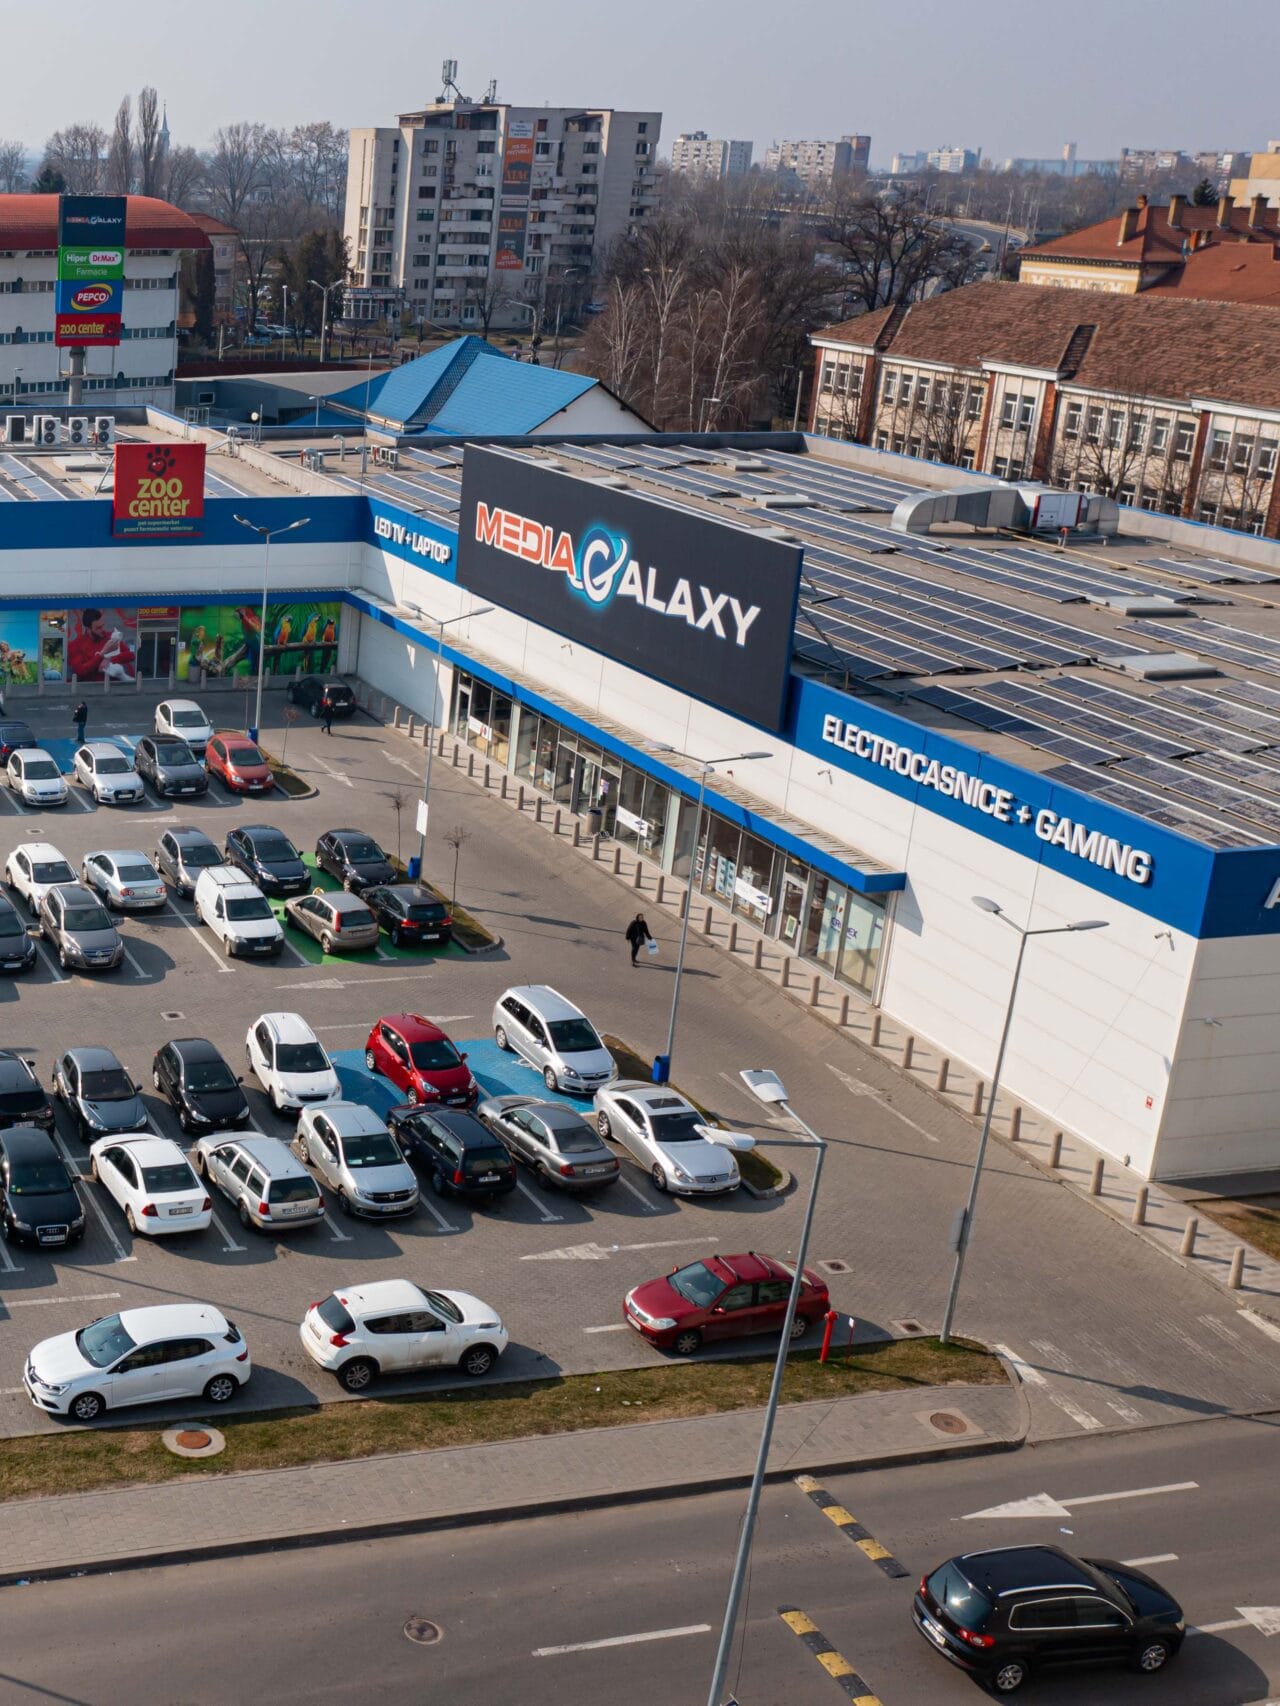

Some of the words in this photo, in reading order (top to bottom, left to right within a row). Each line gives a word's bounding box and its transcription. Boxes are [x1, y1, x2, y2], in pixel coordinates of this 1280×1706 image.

[66, 254, 87, 263] Hiper
[76, 267, 108, 276] Farmacie
[77, 292, 106, 302] PEPCO
[60, 325, 76, 334] zoo
[78, 322, 104, 334] center
[137, 478, 183, 498] zoo
[129, 496, 190, 517] center
[374, 515, 392, 538] LED
[392, 521, 404, 543] TV
[412, 533, 450, 565] LAPTOP
[475, 500, 576, 577] MEDIA
[570, 530, 761, 647] GALAXY
[822, 714, 1013, 822] ELECTROCASNICE
[1016, 805, 1031, 824] +
[1034, 808, 1152, 884] GAMING
